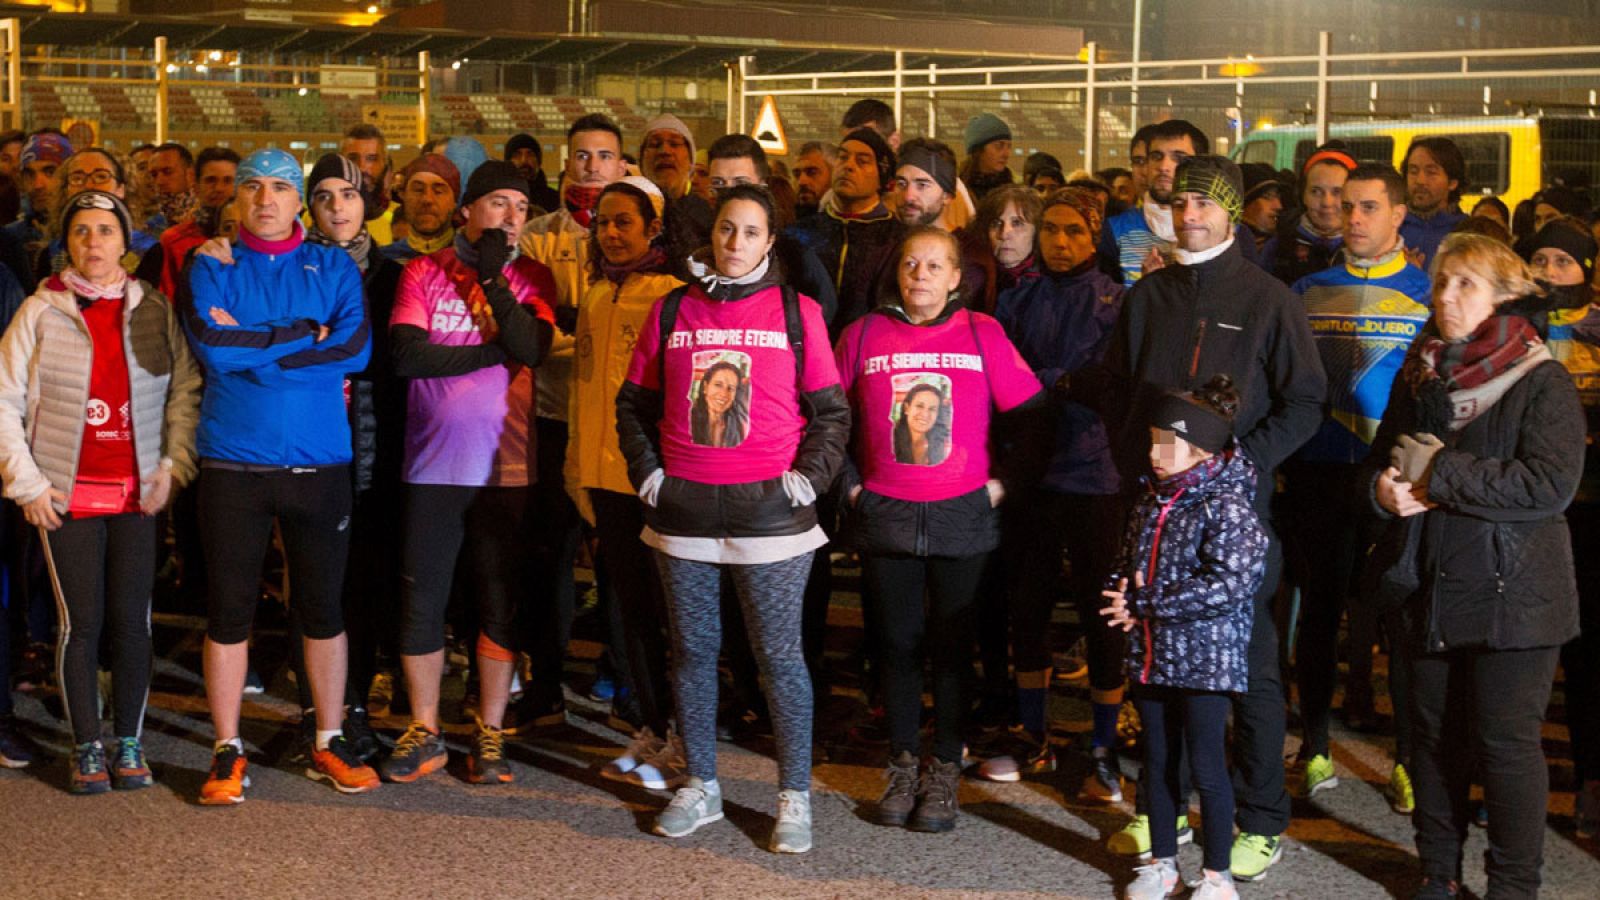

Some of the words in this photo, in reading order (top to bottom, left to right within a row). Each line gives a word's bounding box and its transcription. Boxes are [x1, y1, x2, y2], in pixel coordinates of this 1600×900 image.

[436, 297, 467, 314] WE
[431, 313, 480, 334] REA
[695, 328, 743, 346] SIEMPRE
[744, 328, 789, 350] ETERNA
[891, 352, 940, 369] SIEMPRE
[941, 352, 984, 373] ETERNA
